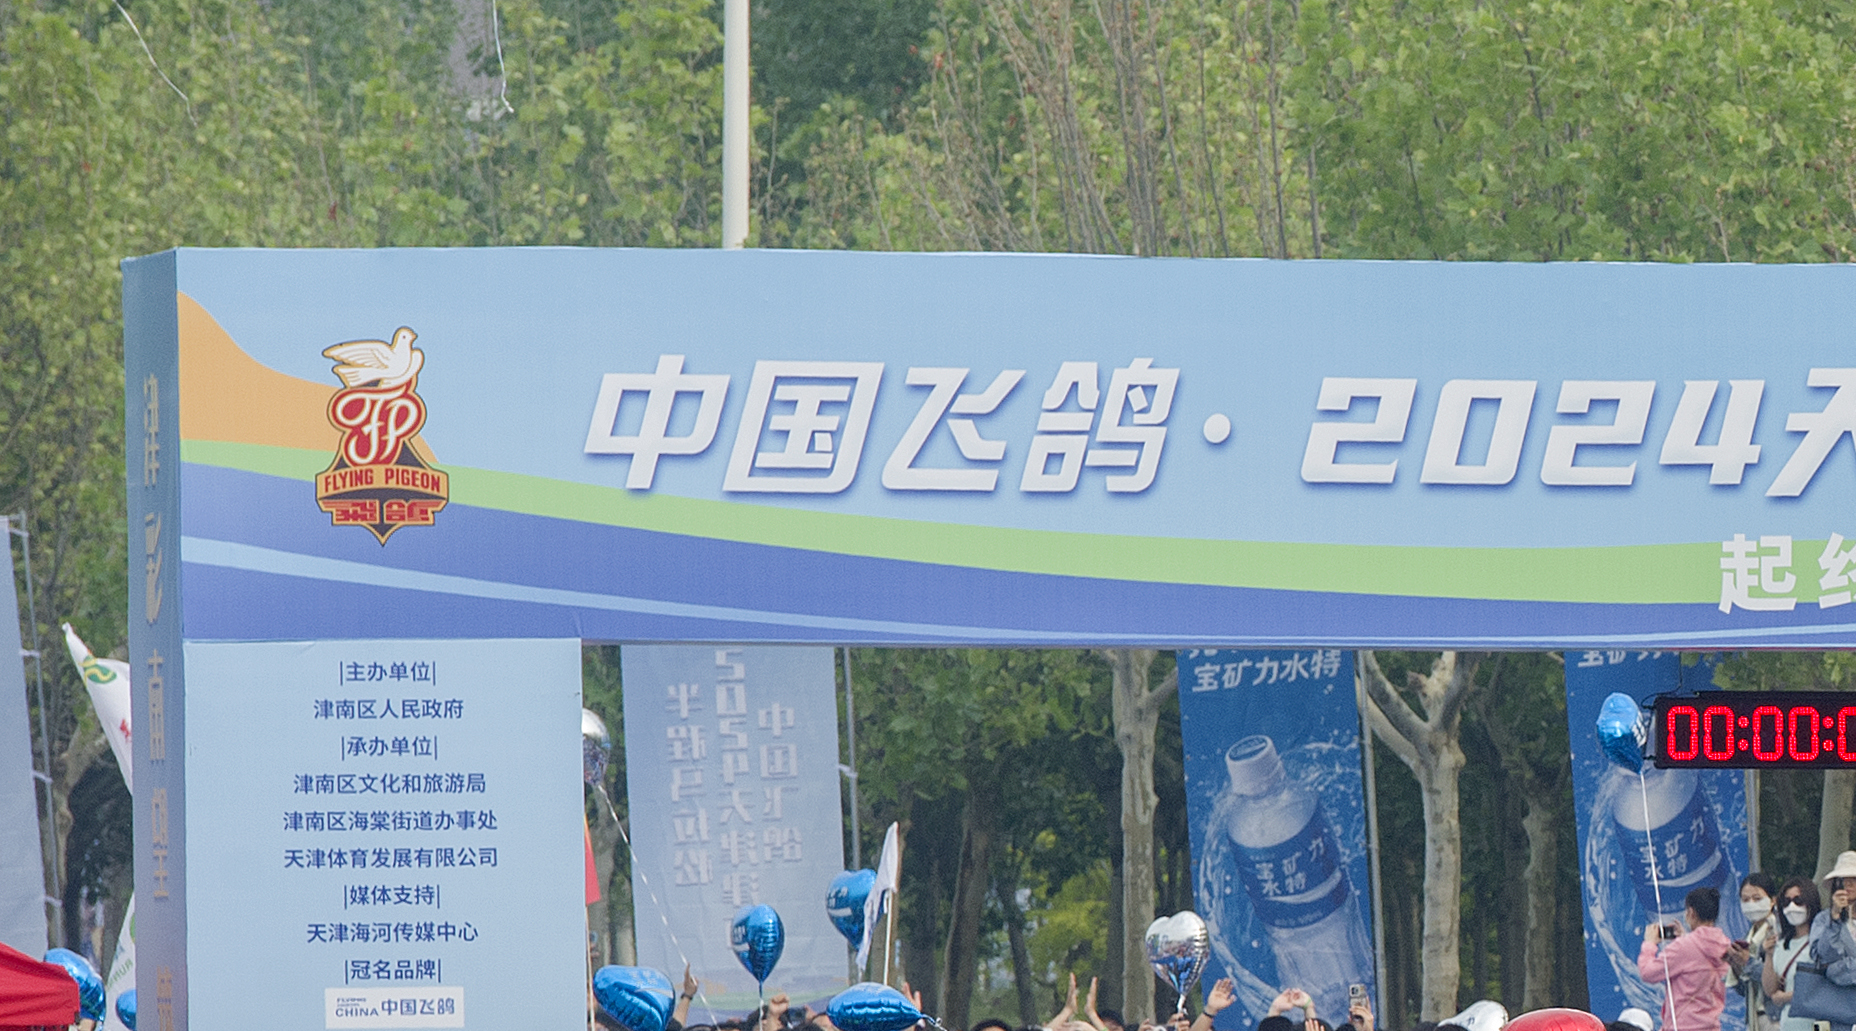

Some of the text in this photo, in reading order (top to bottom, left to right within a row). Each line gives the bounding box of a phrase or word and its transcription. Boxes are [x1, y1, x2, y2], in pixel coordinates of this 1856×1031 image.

[323, 470, 440, 493] FLYING PIGEON
[1191, 652, 1342, 693] 宝矿力水特
[313, 698, 464, 720] 津南区人民政府
[293, 773, 487, 795] 津南区文化和旅游局
[283, 810, 498, 832] 津南区海棠街道办事处
[283, 847, 499, 869] 天津体育发展有限公司
[1254, 837, 1325, 881] 宝矿力
[306, 921, 479, 944] 天津海河传媒中心
[335, 1007, 379, 1018] CHINA
[381, 997, 455, 1016] 中国飞鸽
